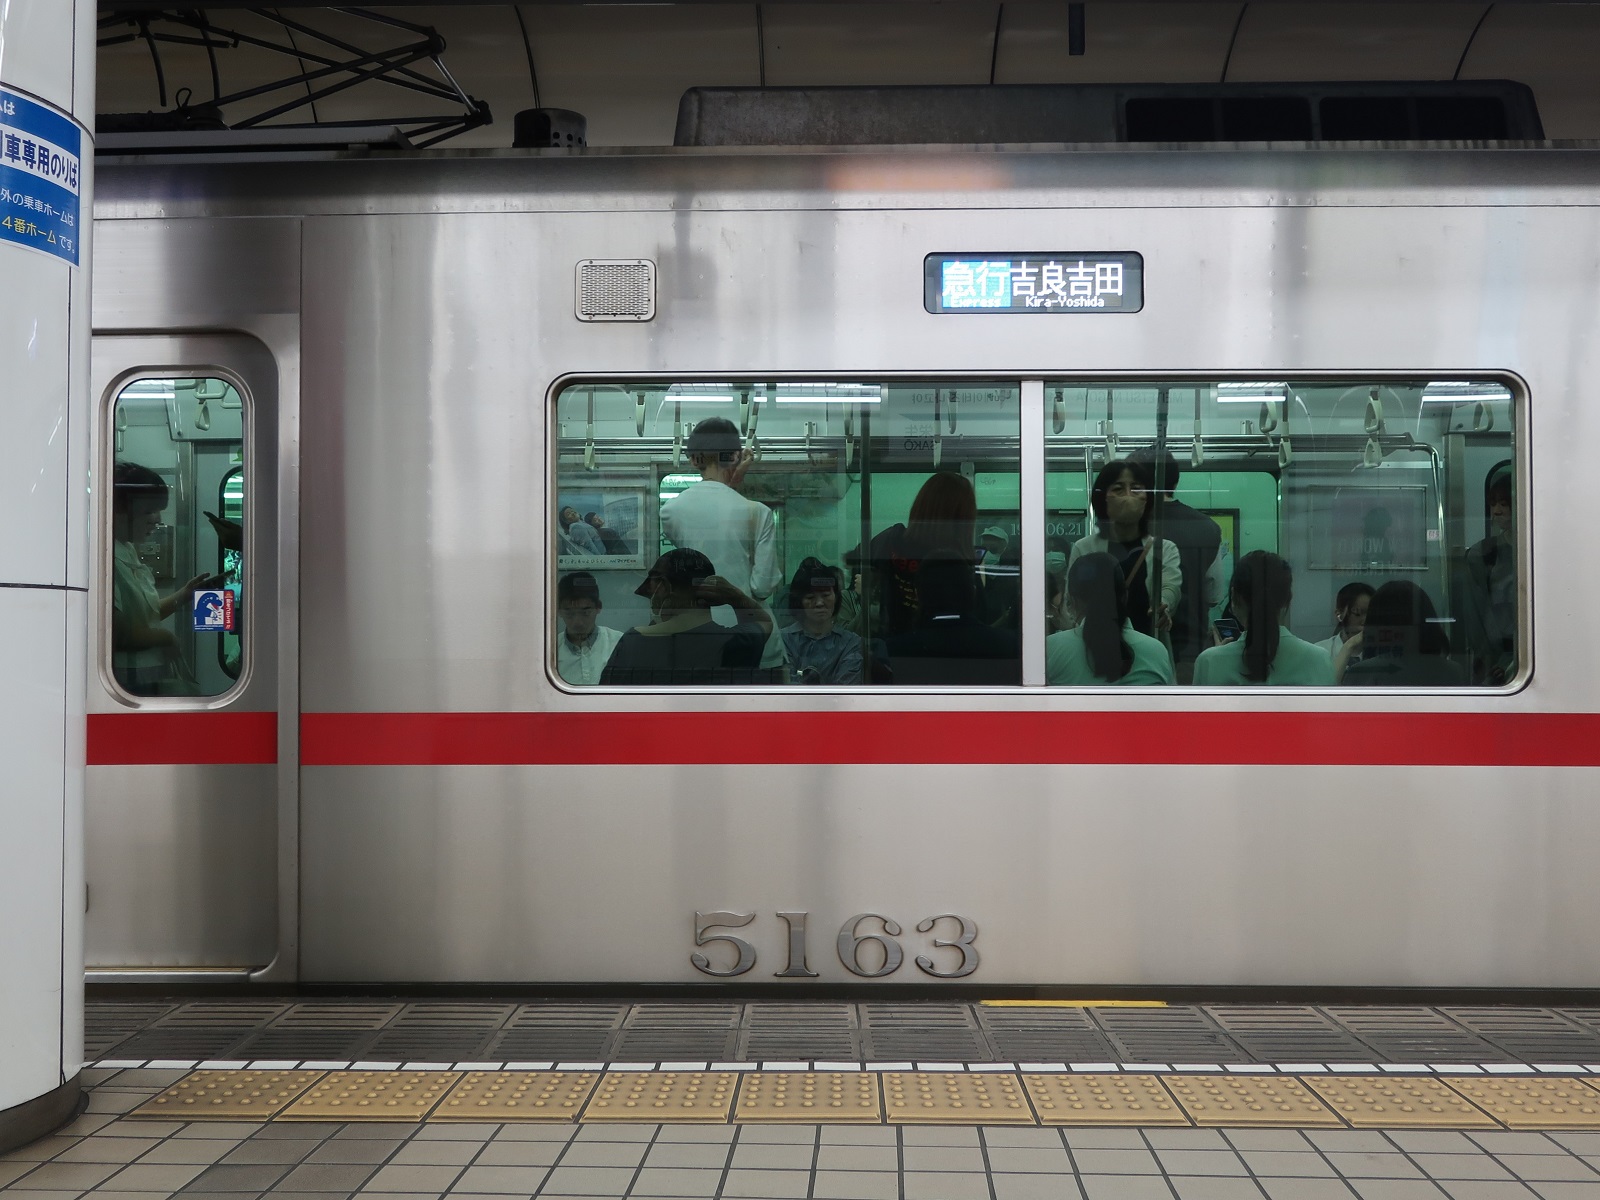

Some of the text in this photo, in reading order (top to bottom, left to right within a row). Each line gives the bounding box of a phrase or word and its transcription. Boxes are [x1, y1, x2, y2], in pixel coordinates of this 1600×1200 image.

[0, 187, 74, 227] 外の乗車ホームは
[942, 261, 1123, 297] 急行 吉良吉田
[1025, 295, 1105, 307] Kira-Yoshida
[690, 910, 979, 978] 5163
